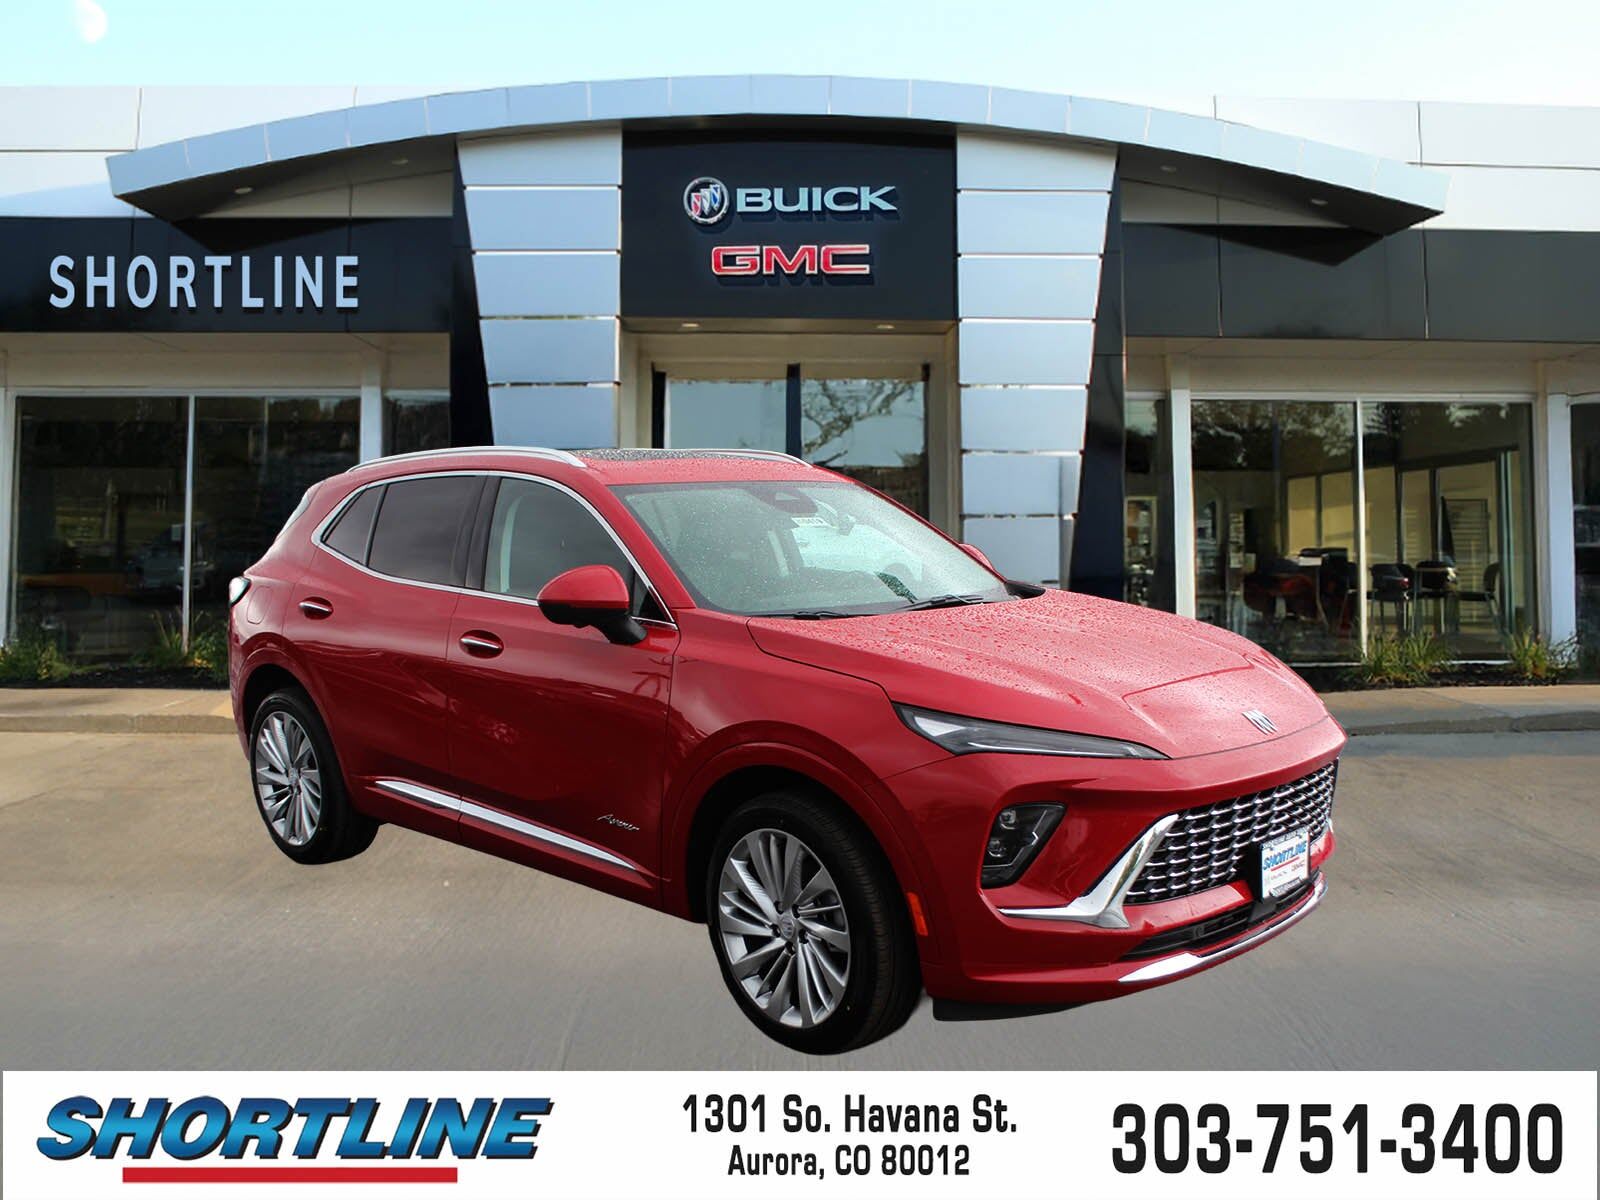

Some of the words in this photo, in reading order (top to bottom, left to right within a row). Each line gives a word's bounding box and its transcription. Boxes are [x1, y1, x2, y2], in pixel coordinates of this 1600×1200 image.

[735, 186, 898, 212] BUICK
[711, 244, 870, 275] GMC
[49, 256, 360, 309] SHORTLINE
[1262, 841, 1307, 870] SHORTLINE
